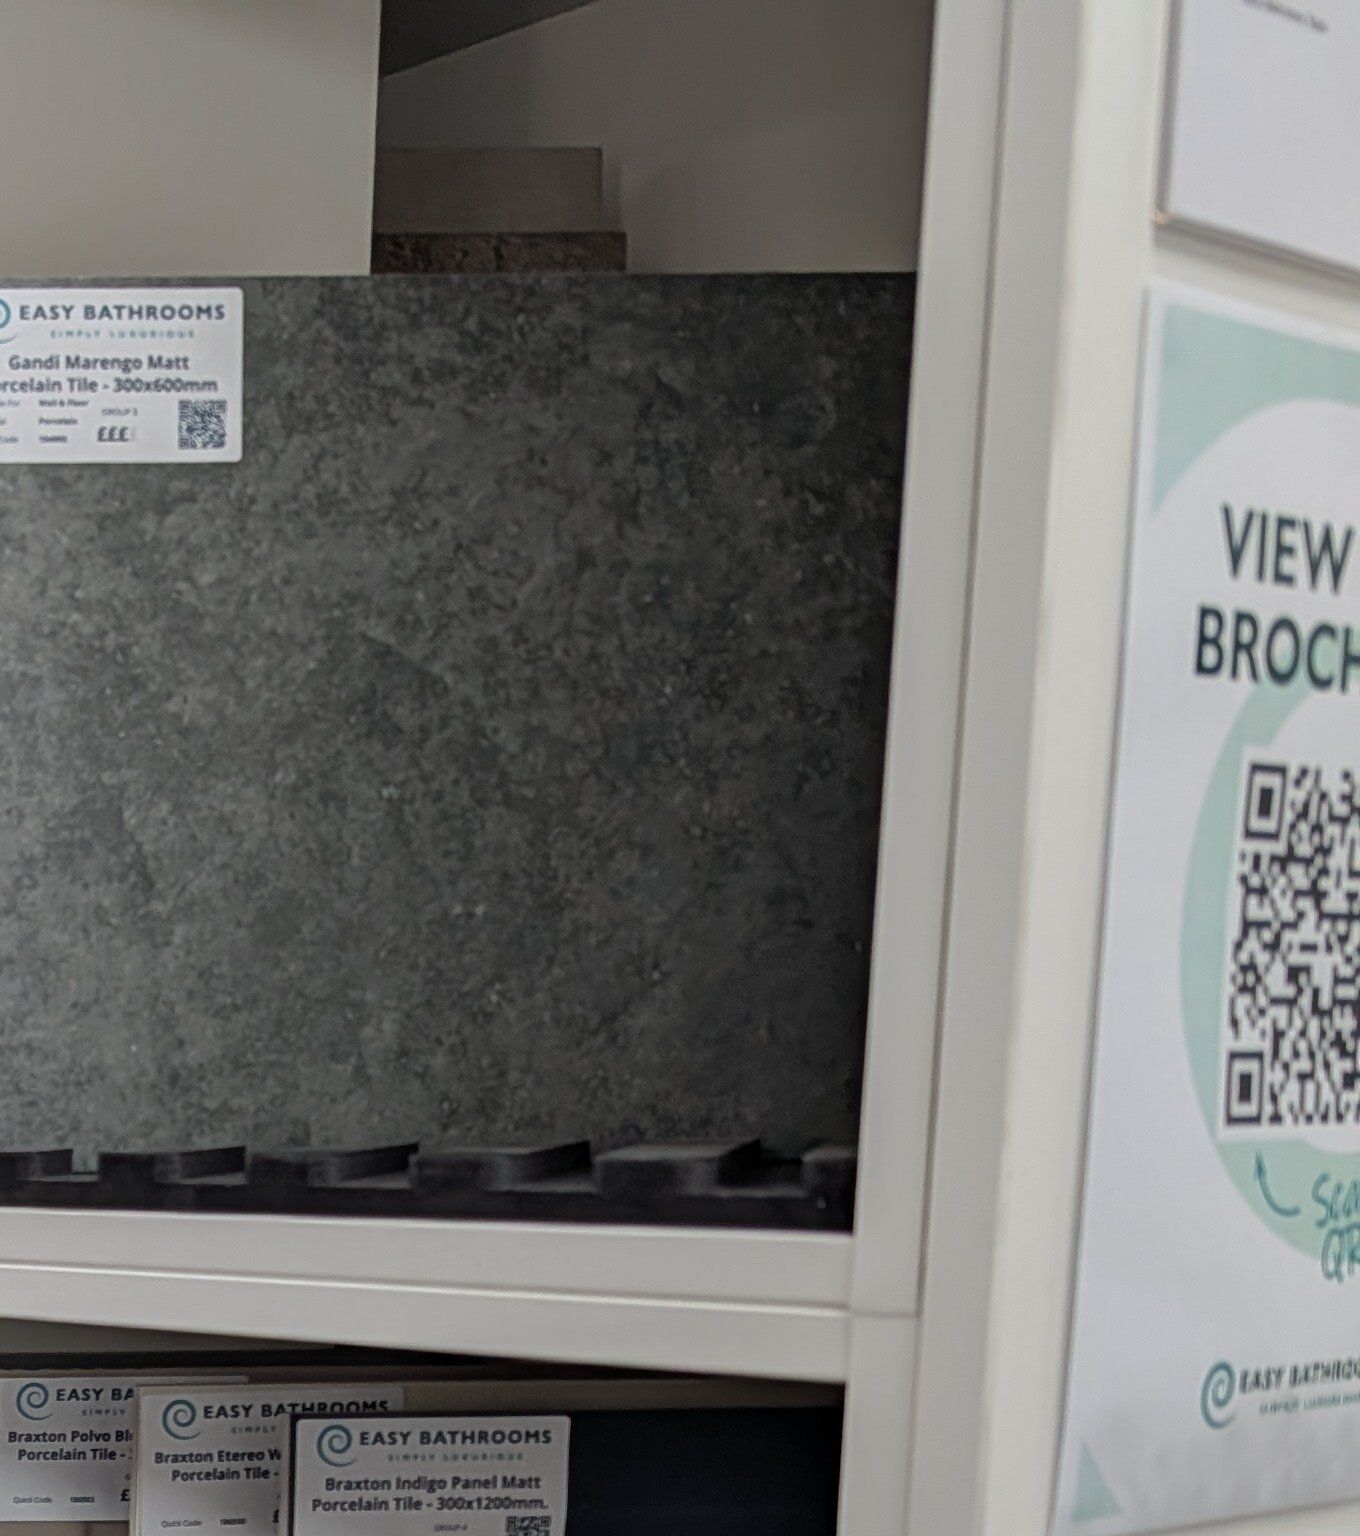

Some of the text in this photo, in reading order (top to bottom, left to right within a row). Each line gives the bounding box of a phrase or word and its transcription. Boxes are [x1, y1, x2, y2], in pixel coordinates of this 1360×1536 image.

[19, 305, 225, 320] EASY BATHROOMS
[9, 355, 189, 374] Gandi Marengo Matt
[68, 378, 98, 393] Tile
[113, 378, 217, 393] 300x600mm
[1220, 502, 1355, 595] VIEW
[56, 1389, 103, 1401] EASY
[203, 1404, 253, 1419] EASY
[8, 1430, 111, 1443] Braxton Polvo
[360, 1430, 552, 1446] EASY BATHROOMS
[18, 1448, 116, 1461] Porcelain Tile
[154, 1451, 265, 1464] Braxton Etereo
[172, 1468, 270, 1481] Porcelain Tile
[325, 1476, 540, 1493] Braxton Indigo Panel Matt
[312, 1499, 389, 1512] Porcelain
[393, 1498, 423, 1511] Tile
